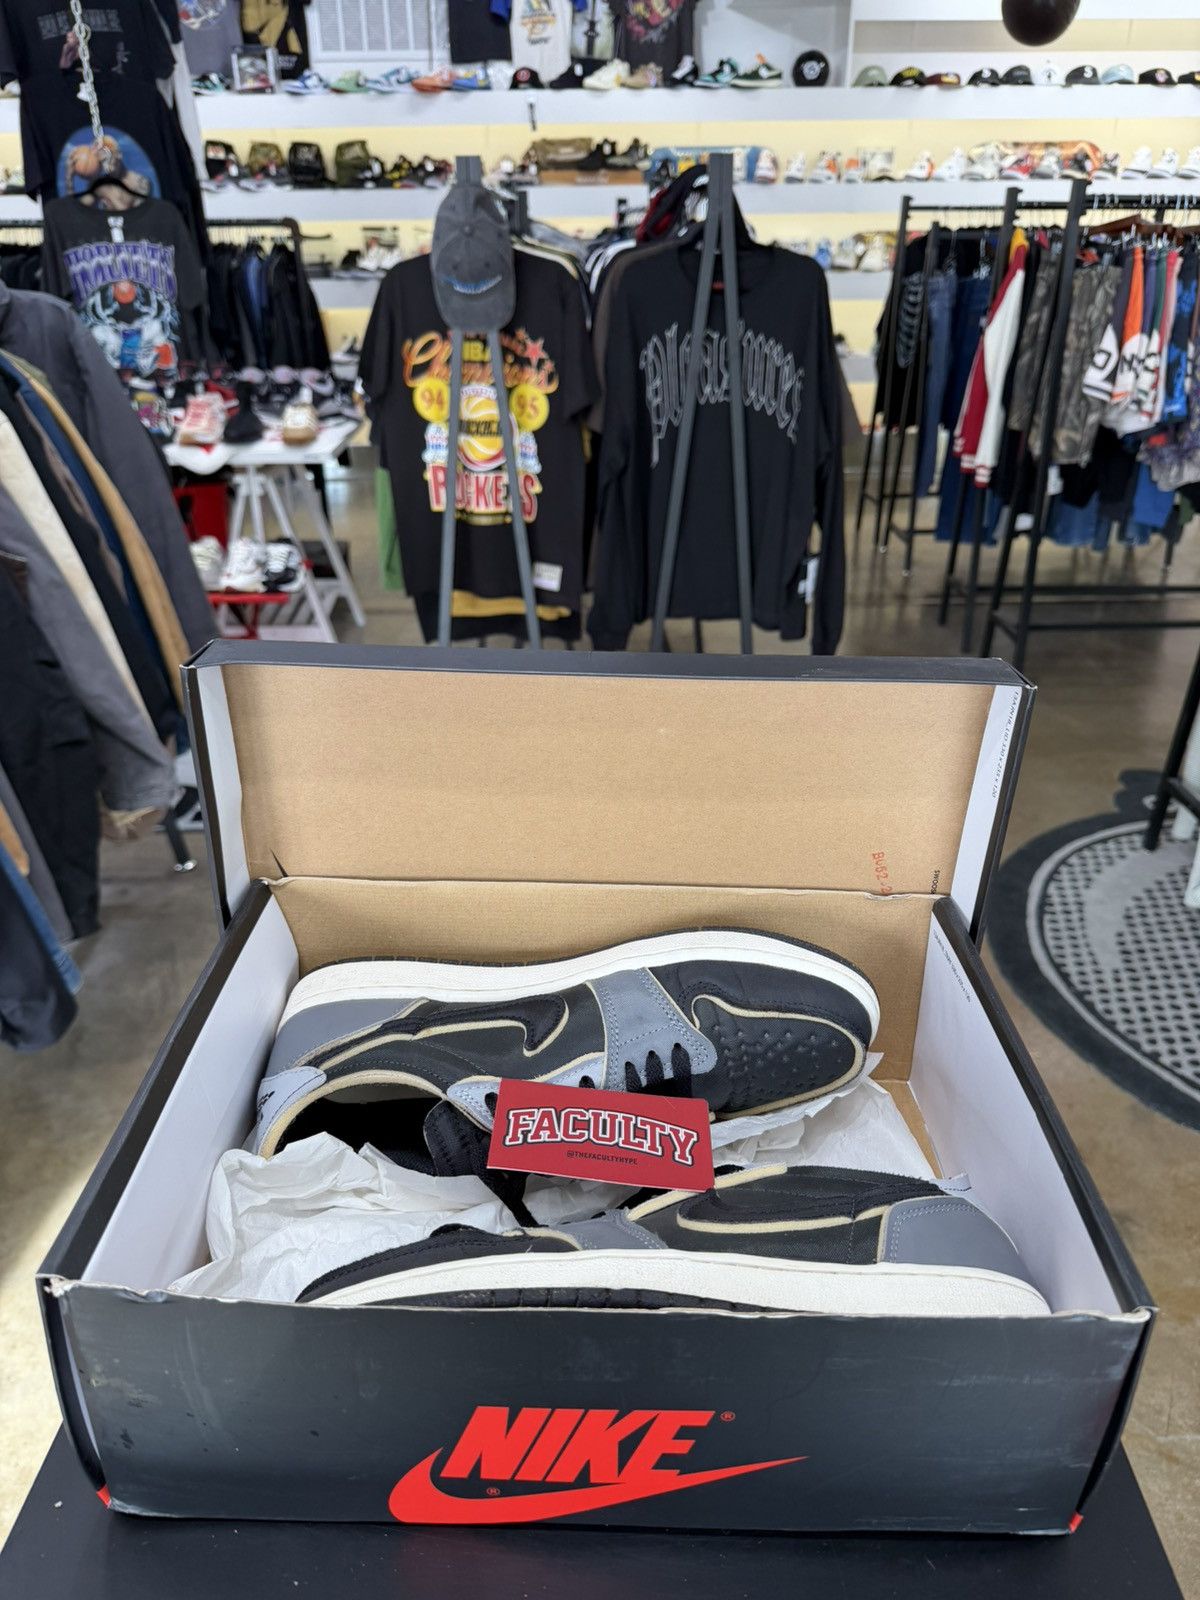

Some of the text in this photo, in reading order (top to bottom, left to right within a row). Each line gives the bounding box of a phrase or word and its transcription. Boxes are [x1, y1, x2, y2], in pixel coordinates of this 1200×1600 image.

[504, 1107, 698, 1168] FACULTY
[566, 1150, 638, 1165] @THEFACULTYHYPE
[440, 1405, 716, 1484] NIKE
